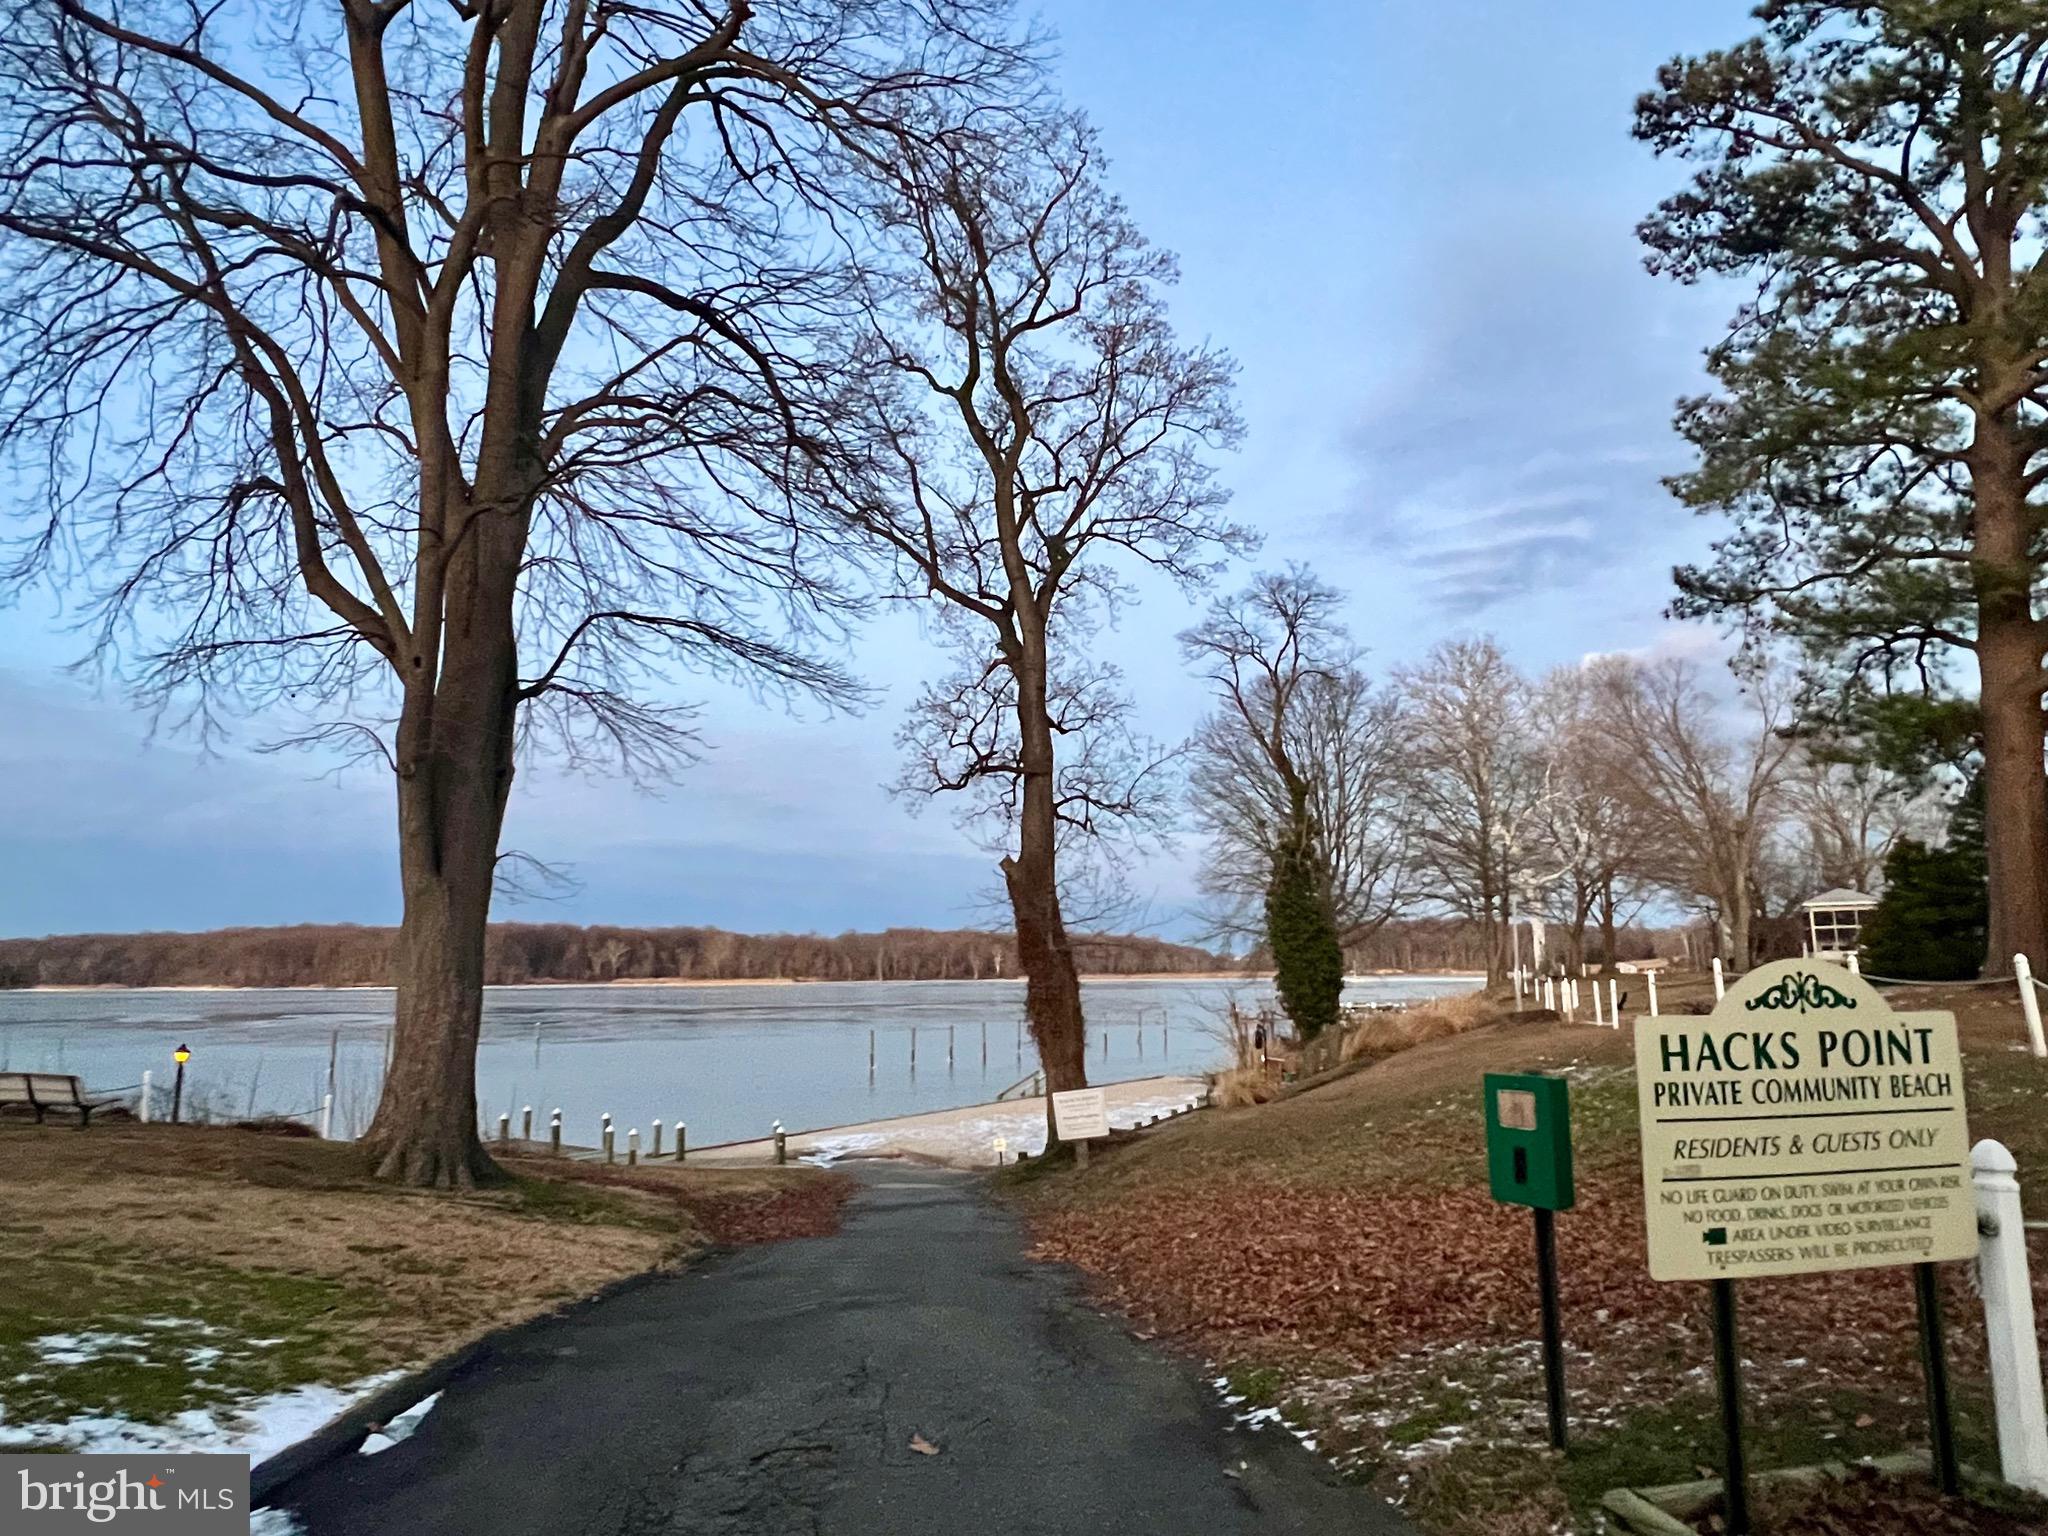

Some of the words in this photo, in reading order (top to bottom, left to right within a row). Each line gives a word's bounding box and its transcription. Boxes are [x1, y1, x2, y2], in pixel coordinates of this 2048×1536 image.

[1660, 1031, 1800, 1072] HACKS
[1818, 1028, 1933, 1068] POINT
[1654, 1080, 1743, 1107] PRIVATE
[1752, 1076, 1881, 1104] COMMUNITY
[1890, 1073, 1953, 1099] BEACH
[1674, 1136, 1781, 1160] RESIDENTS
[1789, 1134, 1803, 1155] &
[1812, 1131, 1881, 1154] GUESTS
[1889, 1127, 1940, 1149] ONLY
[1660, 1190, 1683, 1205] NO
[1687, 1189, 1708, 1204] LIFE
[1713, 1187, 1757, 1203] GUARD
[1761, 1186, 1781, 1201] ON
[1857, 1180, 1871, 1194] AT
[1875, 1179, 1906, 1193] YOUR
[1683, 1210, 1703, 1224] NO
[1732, 1228, 1765, 1242] AREA
[1769, 1225, 1810, 1240] UNDER
[1815, 1222, 1851, 1236] VIDEO
[1707, 1248, 1795, 1265] TRESPASSERS
[1799, 1245, 1829, 1259] WILL
[1834, 1243, 1848, 1257] BE
